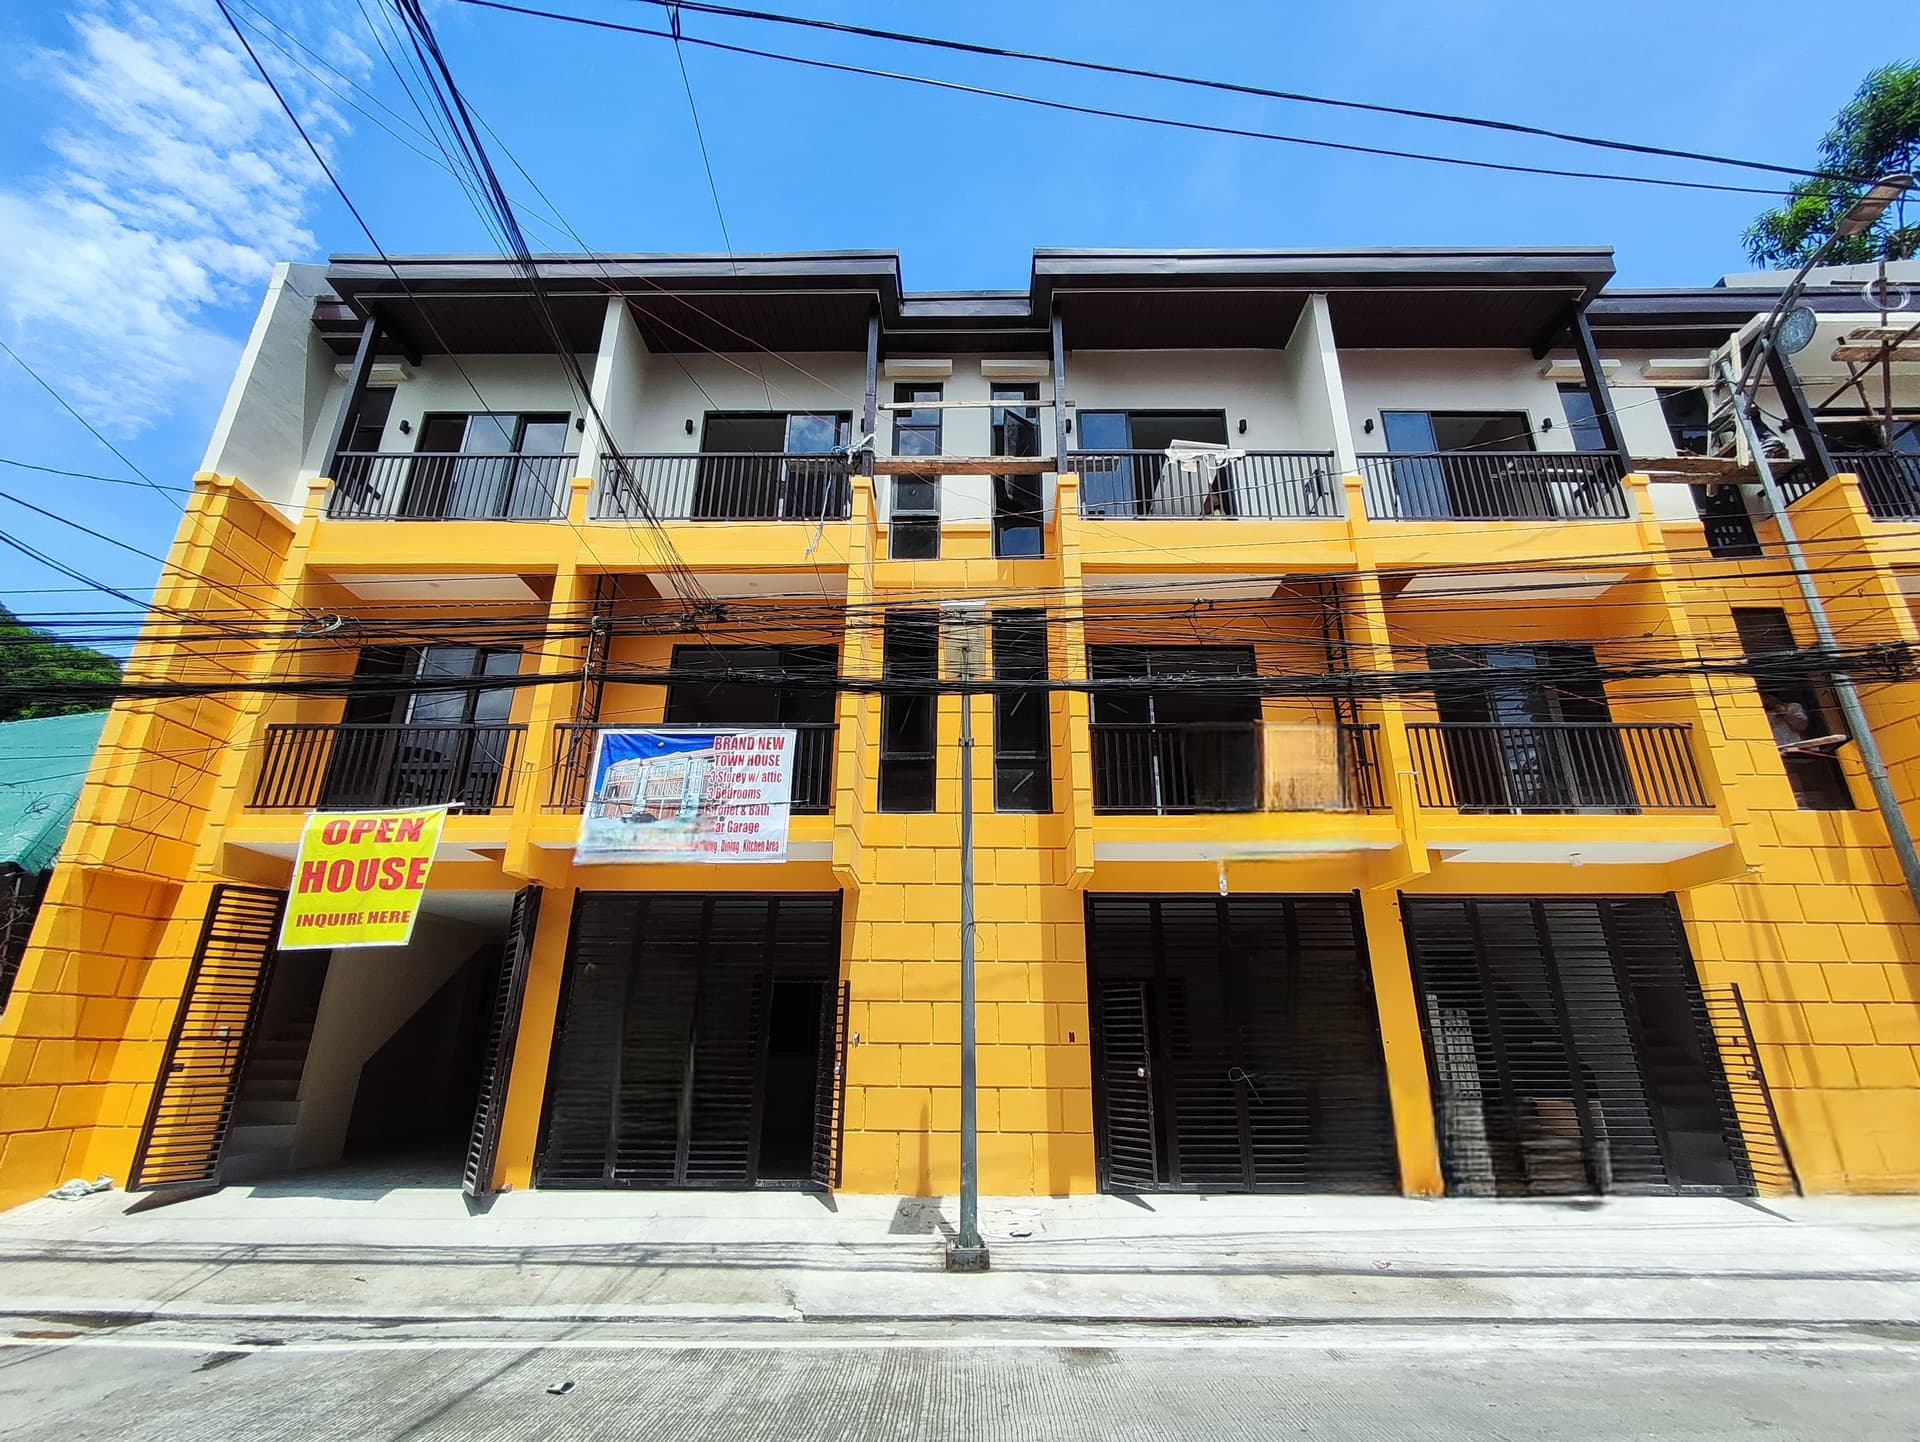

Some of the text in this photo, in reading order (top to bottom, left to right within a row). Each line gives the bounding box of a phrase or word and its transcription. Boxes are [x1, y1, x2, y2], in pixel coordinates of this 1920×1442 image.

[714, 736, 785, 751] BRAND NEW
[715, 754, 781, 767] TOWN HOUSE
[709, 770, 783, 784] 3 Storey w/ attic
[707, 787, 762, 800] 3 Bedrooms
[740, 805, 746, 816] &
[748, 804, 770, 816] Bath
[321, 816, 426, 846] OPEN
[726, 820, 760, 834] Garage
[742, 838, 765, 853] Kitchen
[765, 839, 780, 853] Area
[298, 857, 430, 894] HOUSE
[296, 909, 412, 928] INQUIRE HERE
